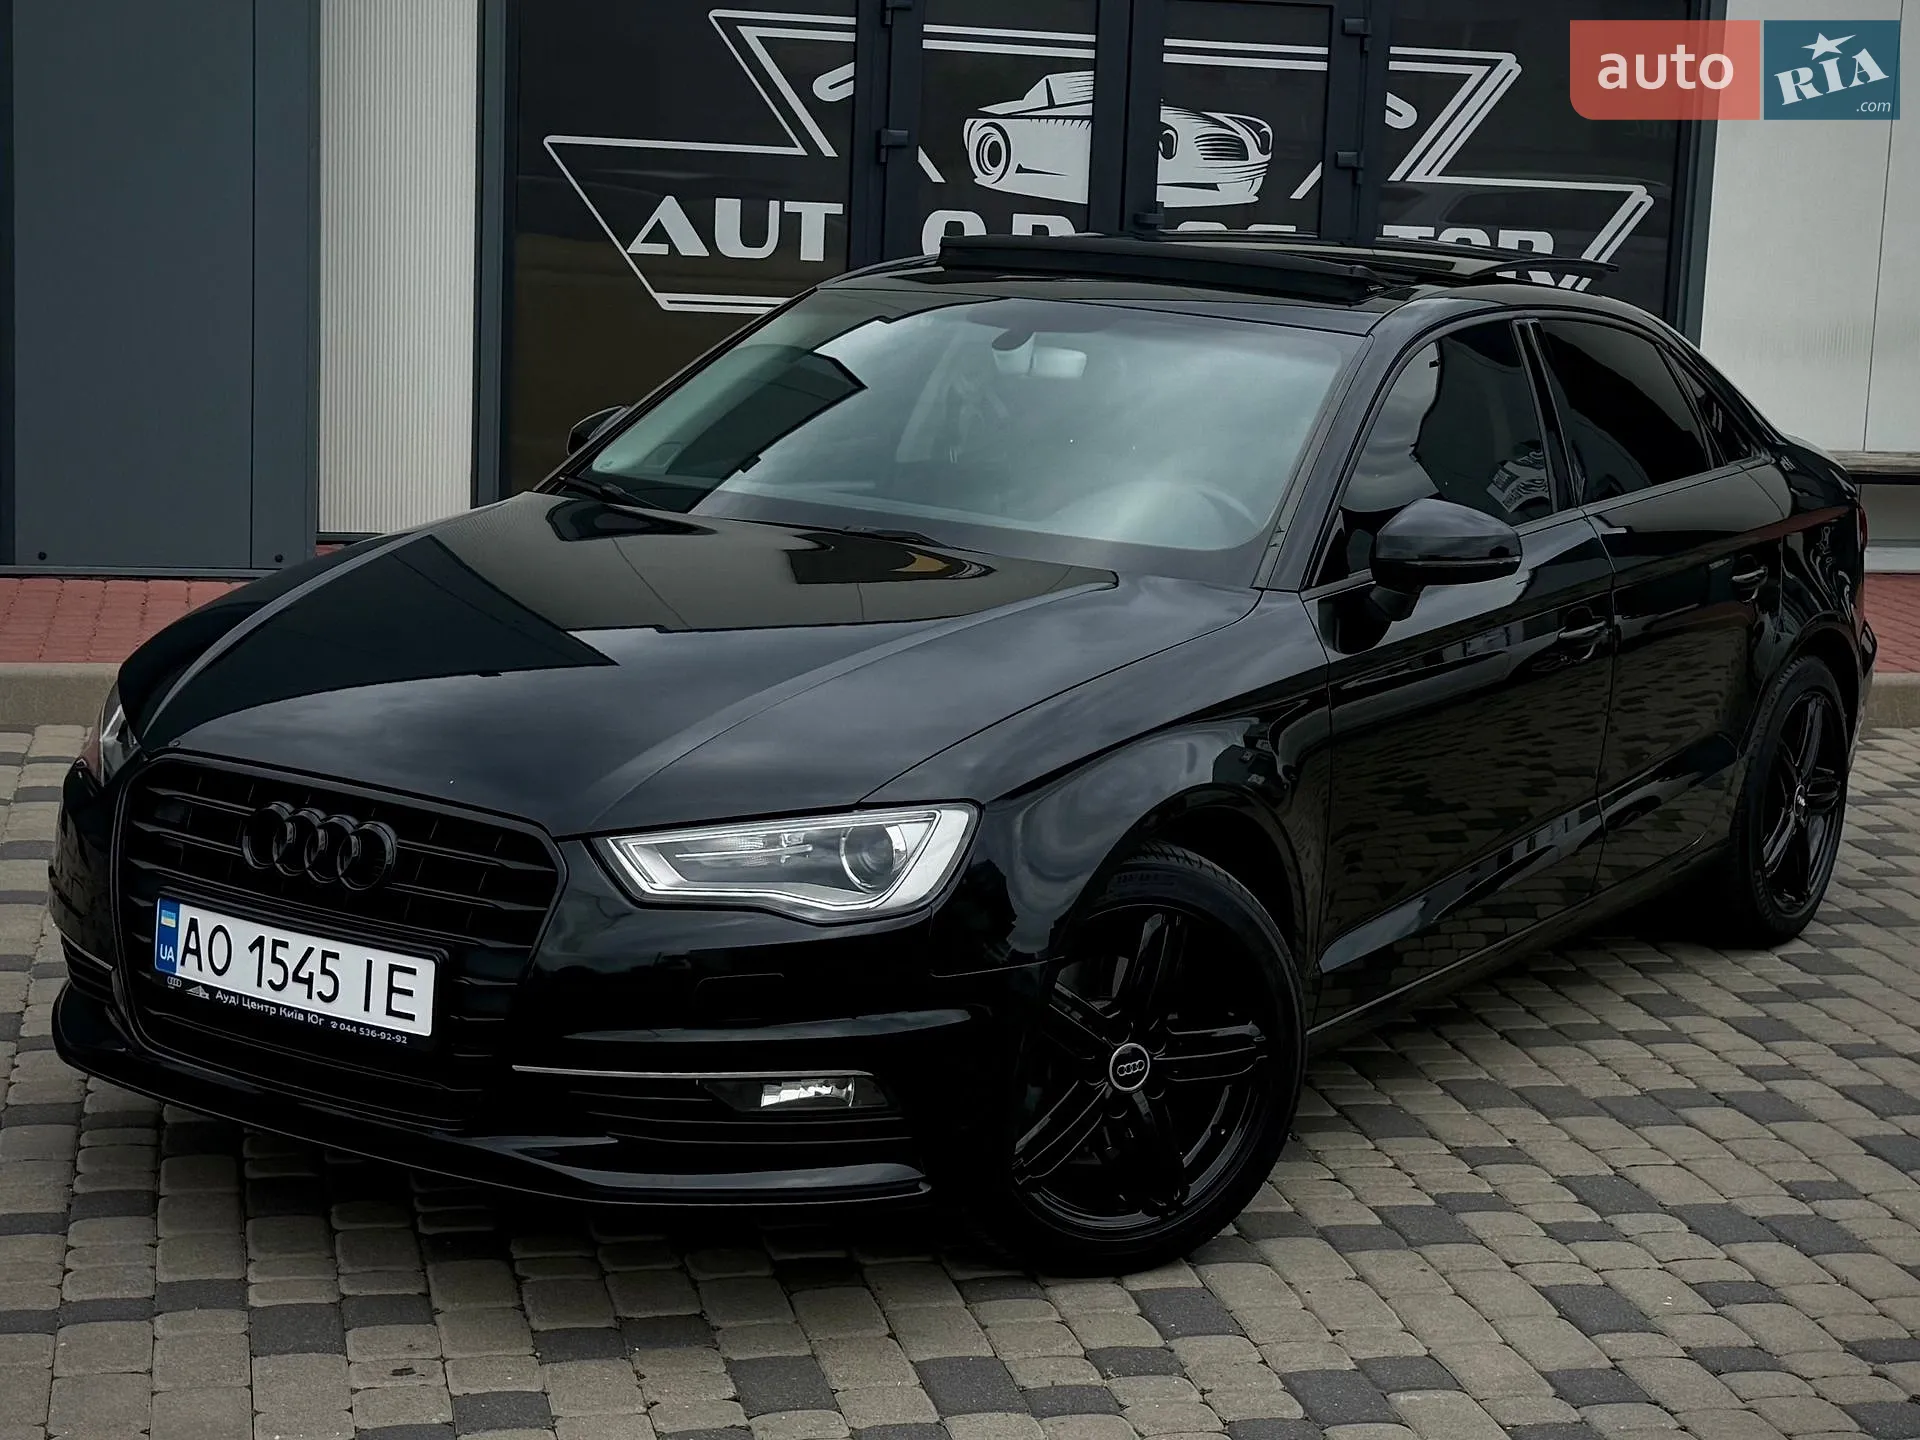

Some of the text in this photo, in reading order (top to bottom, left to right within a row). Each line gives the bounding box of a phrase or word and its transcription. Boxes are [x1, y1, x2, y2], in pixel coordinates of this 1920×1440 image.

[160, 944, 175, 963] UA
[180, 916, 418, 1022] AO 1545 IE
[215, 990, 239, 1006] Ауді
[242, 995, 277, 1016] Центр
[279, 1007, 305, 1021] Київ
[307, 1012, 325, 1026] Юг
[339, 1023, 357, 1034] 044
